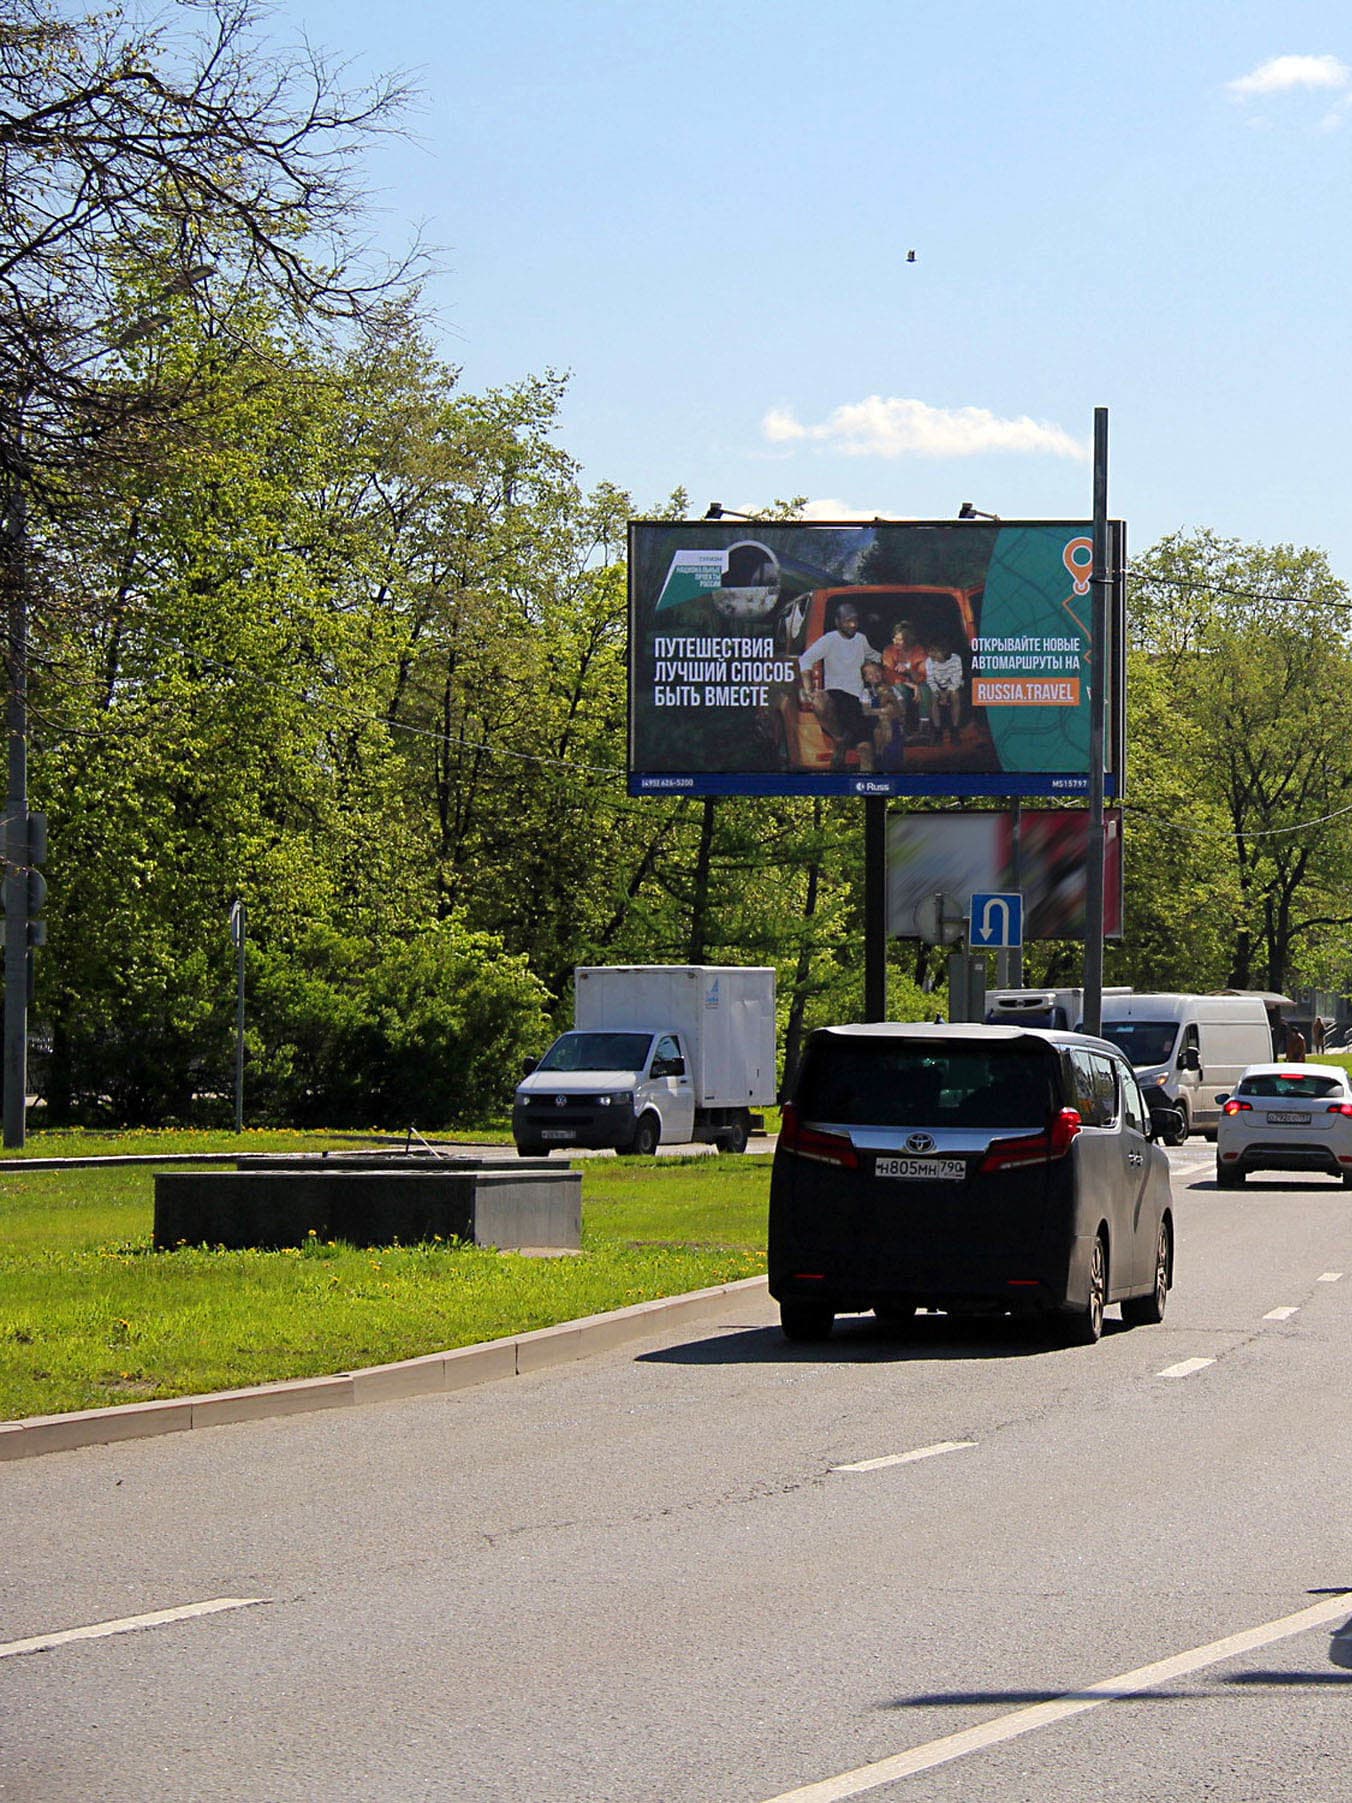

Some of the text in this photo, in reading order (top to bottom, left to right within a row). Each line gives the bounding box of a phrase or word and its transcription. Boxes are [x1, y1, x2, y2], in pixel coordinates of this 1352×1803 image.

[654, 637, 774, 658] ПУТЕШЕСТВИЯ
[971, 635, 1080, 652] ОТКРЫВАЙТЕ НОВЫЕ
[654, 657, 795, 682] ЛУЧШИЙ СПОСОБ
[971, 656, 1080, 670] АВТОМАРШРУТЫ НА
[655, 686, 769, 706] БЫТЬ ВМЕСТЕ
[978, 684, 1075, 701] RUSSIA.TRAVEL
[880, 1160, 962, 1176] Н805МН 790
